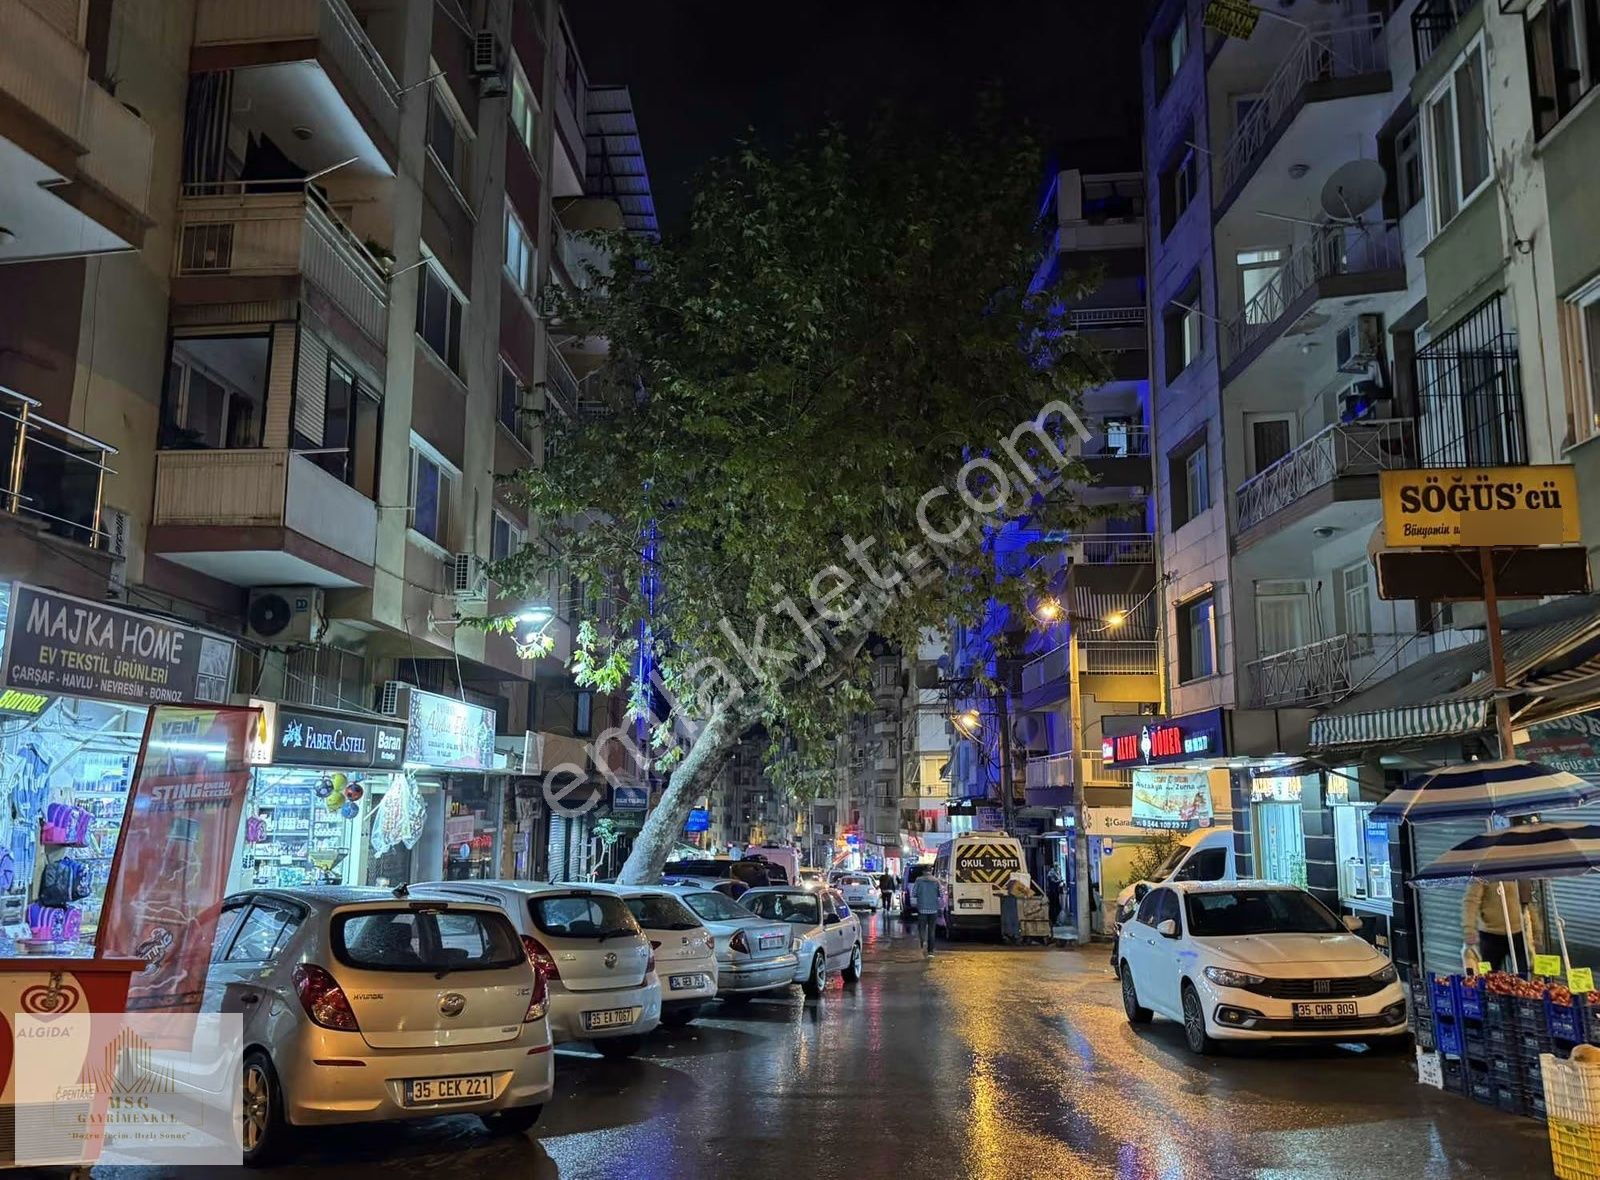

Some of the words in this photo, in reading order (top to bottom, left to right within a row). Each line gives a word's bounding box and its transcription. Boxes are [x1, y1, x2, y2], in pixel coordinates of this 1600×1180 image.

[26, 597, 114, 649] MAJKA
[122, 620, 185, 664] HOME
[39, 645, 57, 664] EV
[61, 649, 110, 674] TEKSTİL
[113, 654, 169, 684] ÜRÜNLERİ
[12, 665, 55, 687] ÇARŞAF
[62, 673, 93, 690] HAVLU
[100, 677, 144, 697] NEVRESİM
[150, 690, 182, 703] BORNOZ
[378, 731, 401, 750] Baran
[1151, 725, 1182, 757] DÖNER
[152, 783, 203, 802] STING
[961, 858, 985, 868] OKUL
[991, 858, 1018, 869] TAŞITI
[1313, 980, 1331, 993] FIAT
[592, 1012, 601, 1024] 35
[1299, 1003, 1311, 1016] 35
[1315, 1003, 1333, 1016] CHR
[1337, 1003, 1355, 1015] 809
[414, 1083, 431, 1099] 35
[438, 1080, 461, 1097] CEK
[466, 1078, 488, 1095] 221
